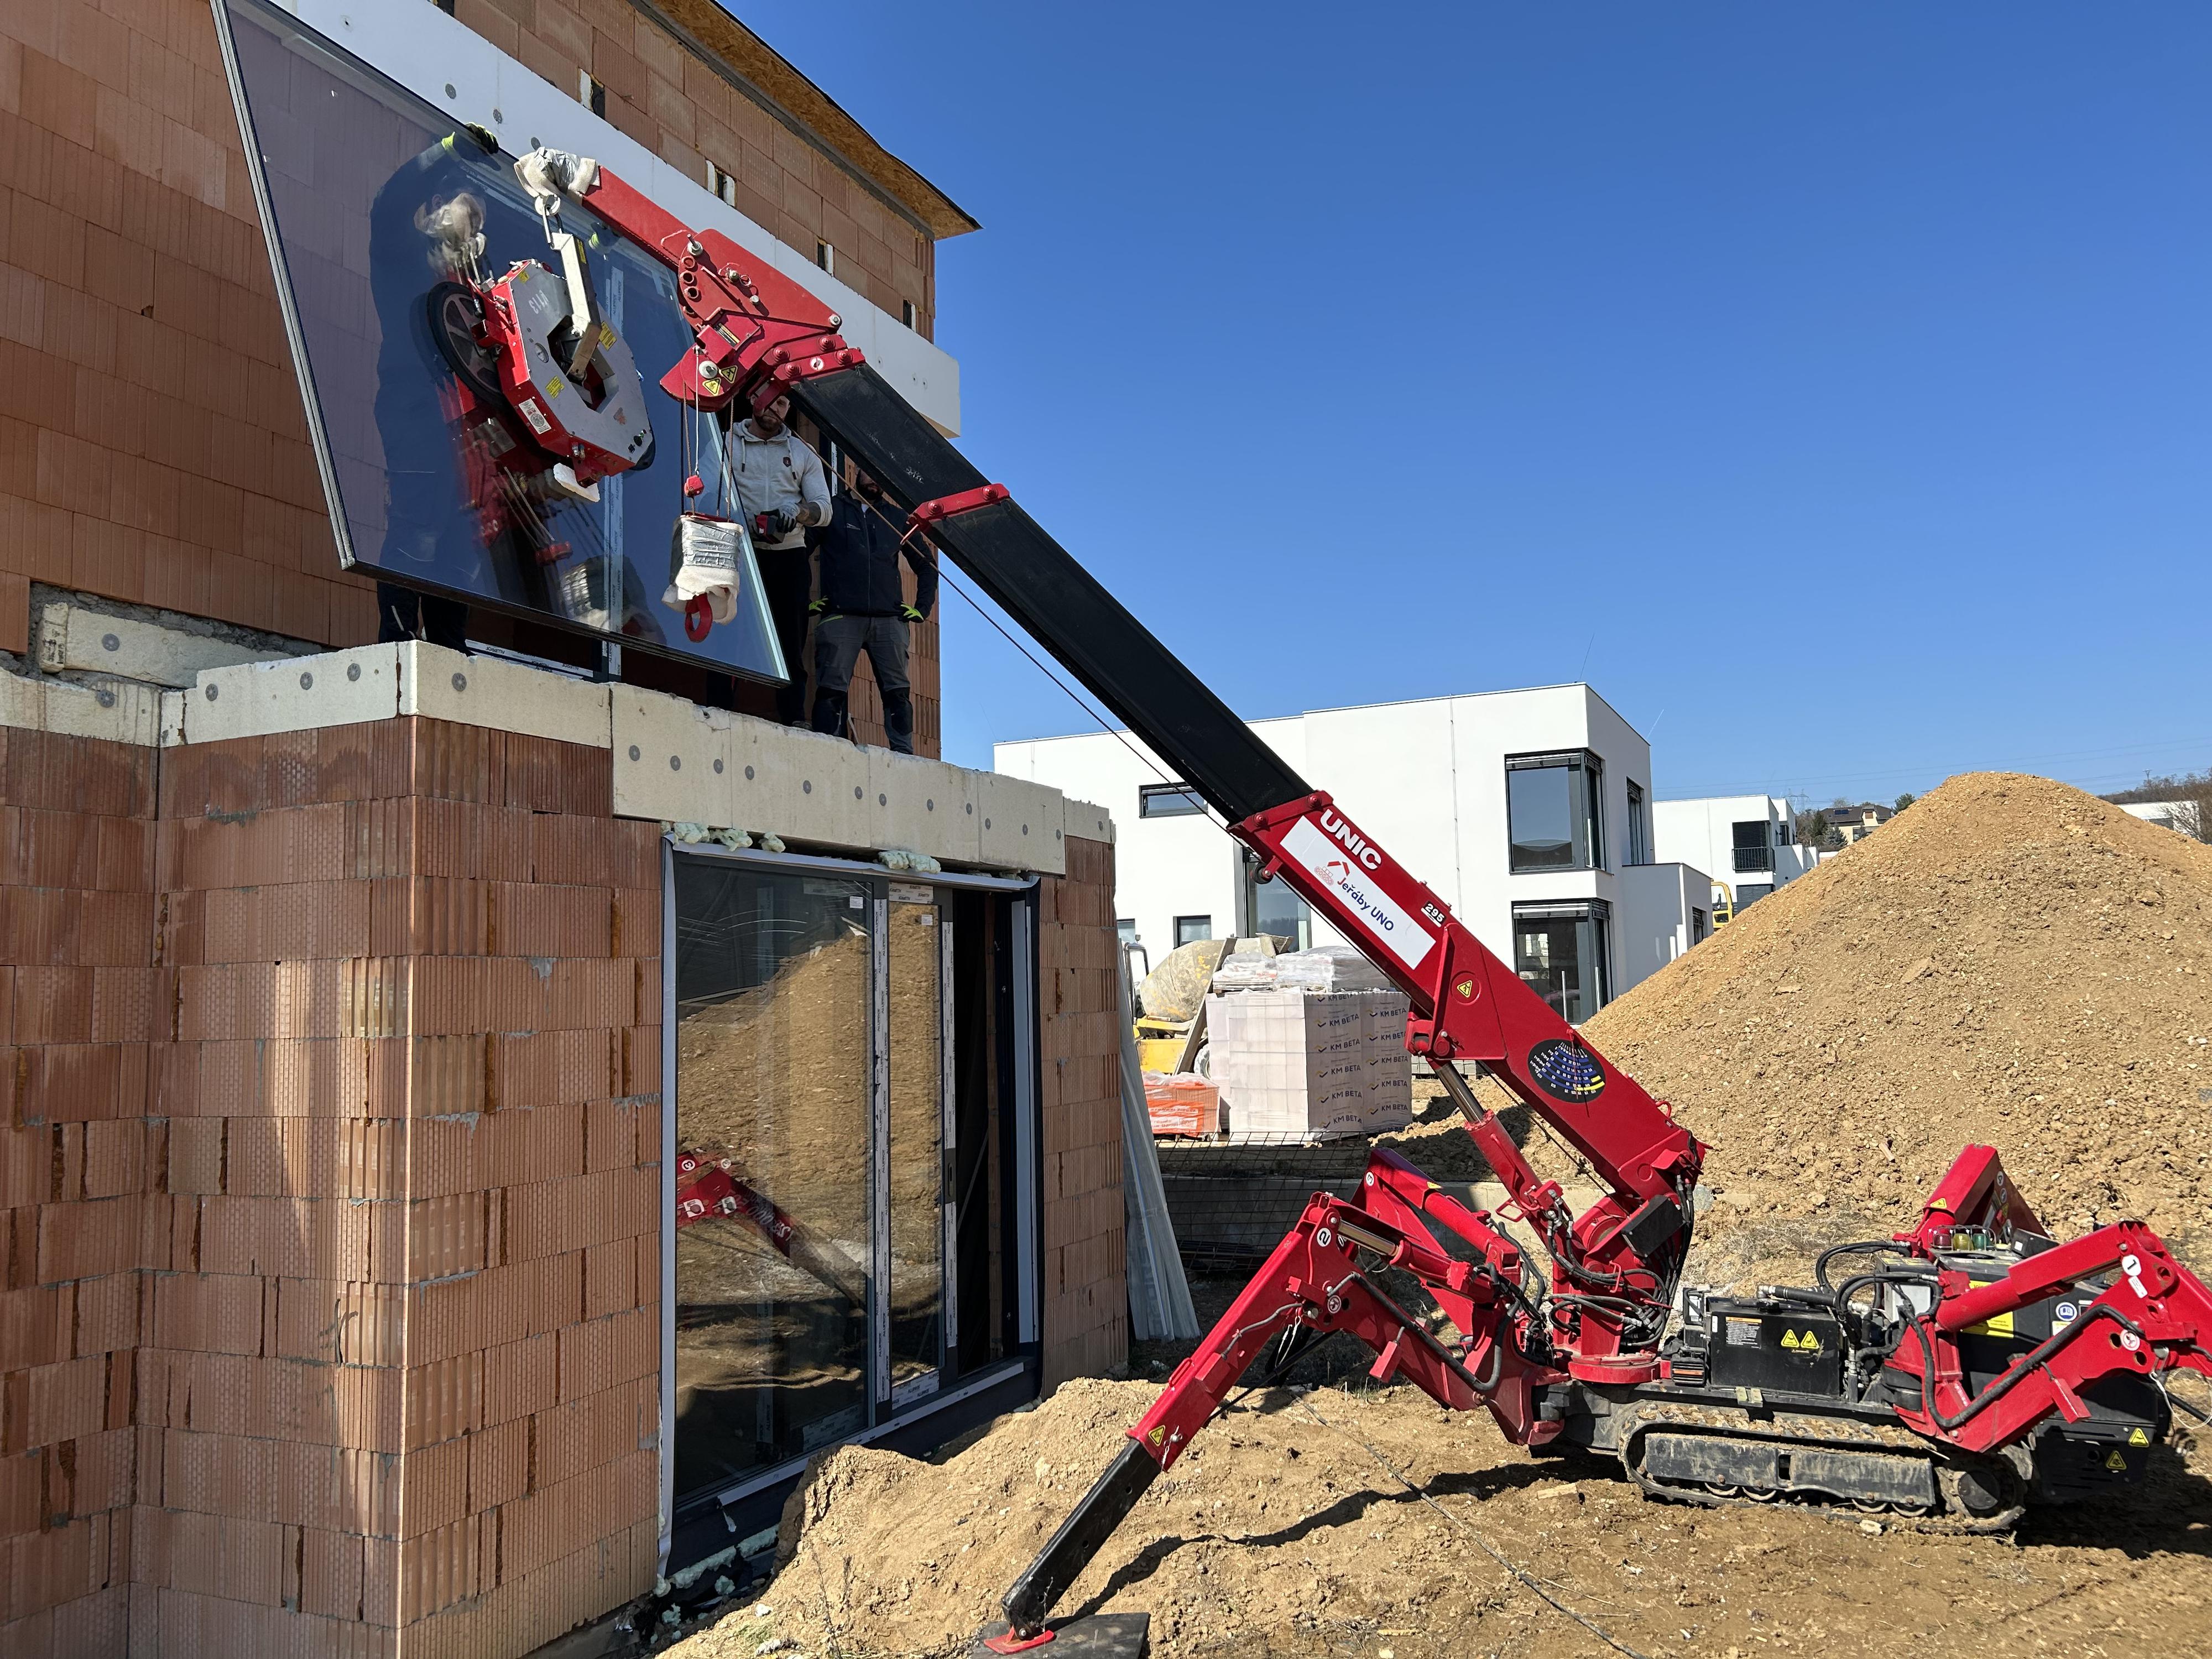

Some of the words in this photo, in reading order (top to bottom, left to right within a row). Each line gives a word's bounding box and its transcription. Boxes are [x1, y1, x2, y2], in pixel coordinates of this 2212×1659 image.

[1320, 808, 1381, 870] UNIC
[1337, 877, 1370, 910] Jeřáby
[1370, 906, 1394, 931] UNO
[1424, 902, 1444, 922] 295
[1391, 1008, 1407, 1016] BETA
[1342, 1014, 1359, 1024] BETA
[1344, 1039, 1360, 1048] BETA
[1367, 1174, 1373, 1184] 3
[1319, 1230, 1330, 1245] 2
[2127, 1259, 2137, 1270] 1
